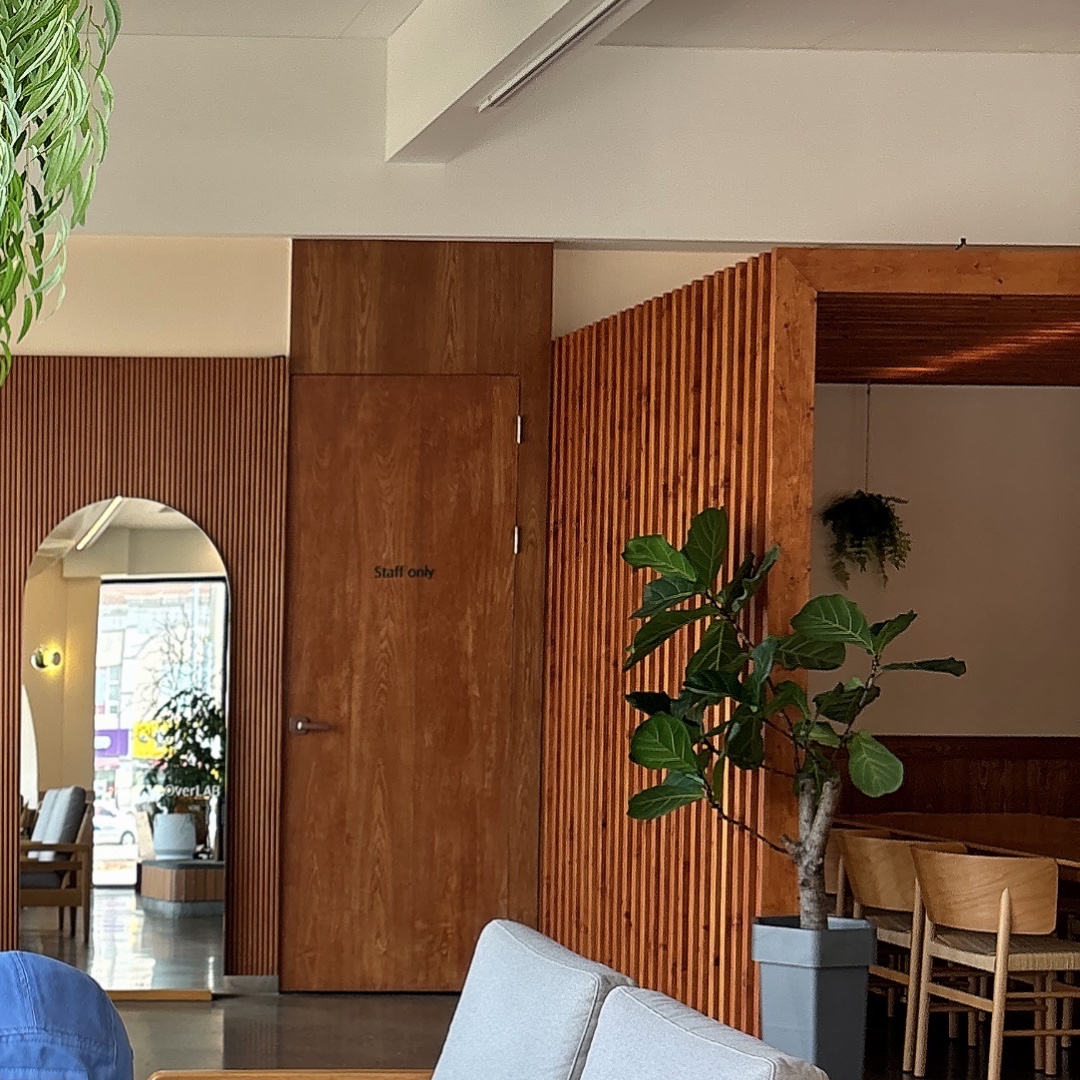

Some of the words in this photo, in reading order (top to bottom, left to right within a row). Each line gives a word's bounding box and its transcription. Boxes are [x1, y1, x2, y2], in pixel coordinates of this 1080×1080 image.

[374, 565, 403, 579] Staff
[407, 565, 435, 580] only
[165, 784, 221, 797] OverLAB
